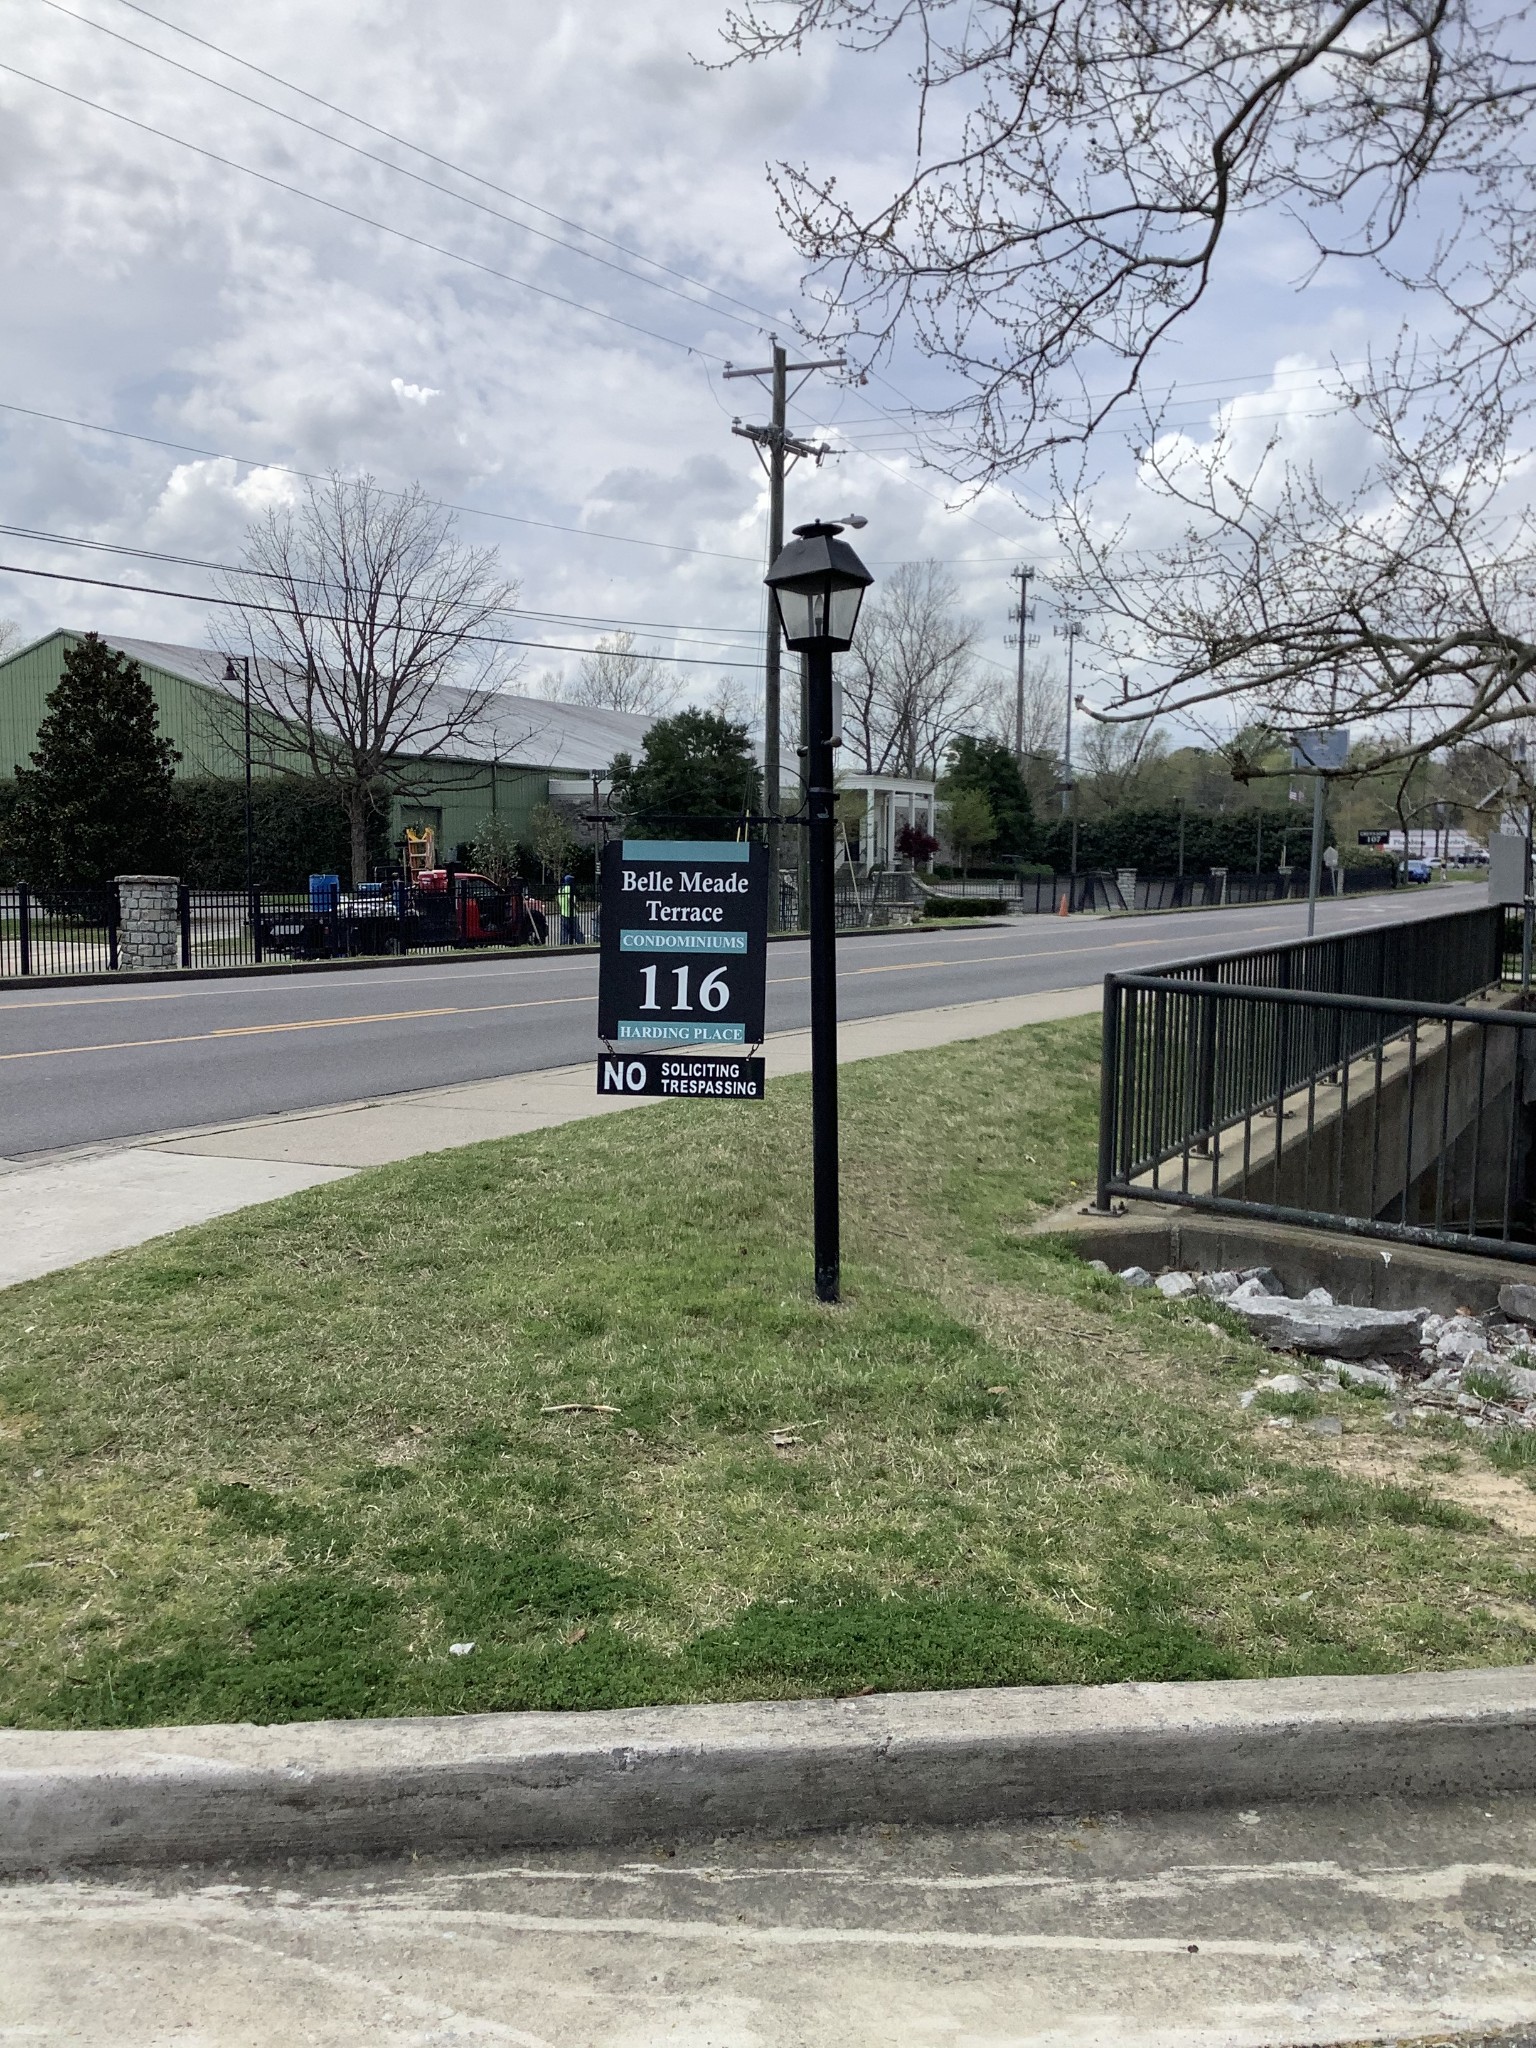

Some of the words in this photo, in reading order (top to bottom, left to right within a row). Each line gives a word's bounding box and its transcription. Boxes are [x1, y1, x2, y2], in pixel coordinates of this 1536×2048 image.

[621, 870, 674, 893] Belle
[678, 872, 749, 894] Meade
[645, 900, 723, 923] Terrace
[623, 934, 745, 949] CONDOMINIUMS
[639, 964, 730, 1012] 116
[620, 1026, 690, 1039] HARDING
[694, 1028, 742, 1041] PLACE
[603, 1061, 647, 1091] NO
[661, 1063, 740, 1078] SOLICITING
[661, 1079, 757, 1096] TRESPASSING
